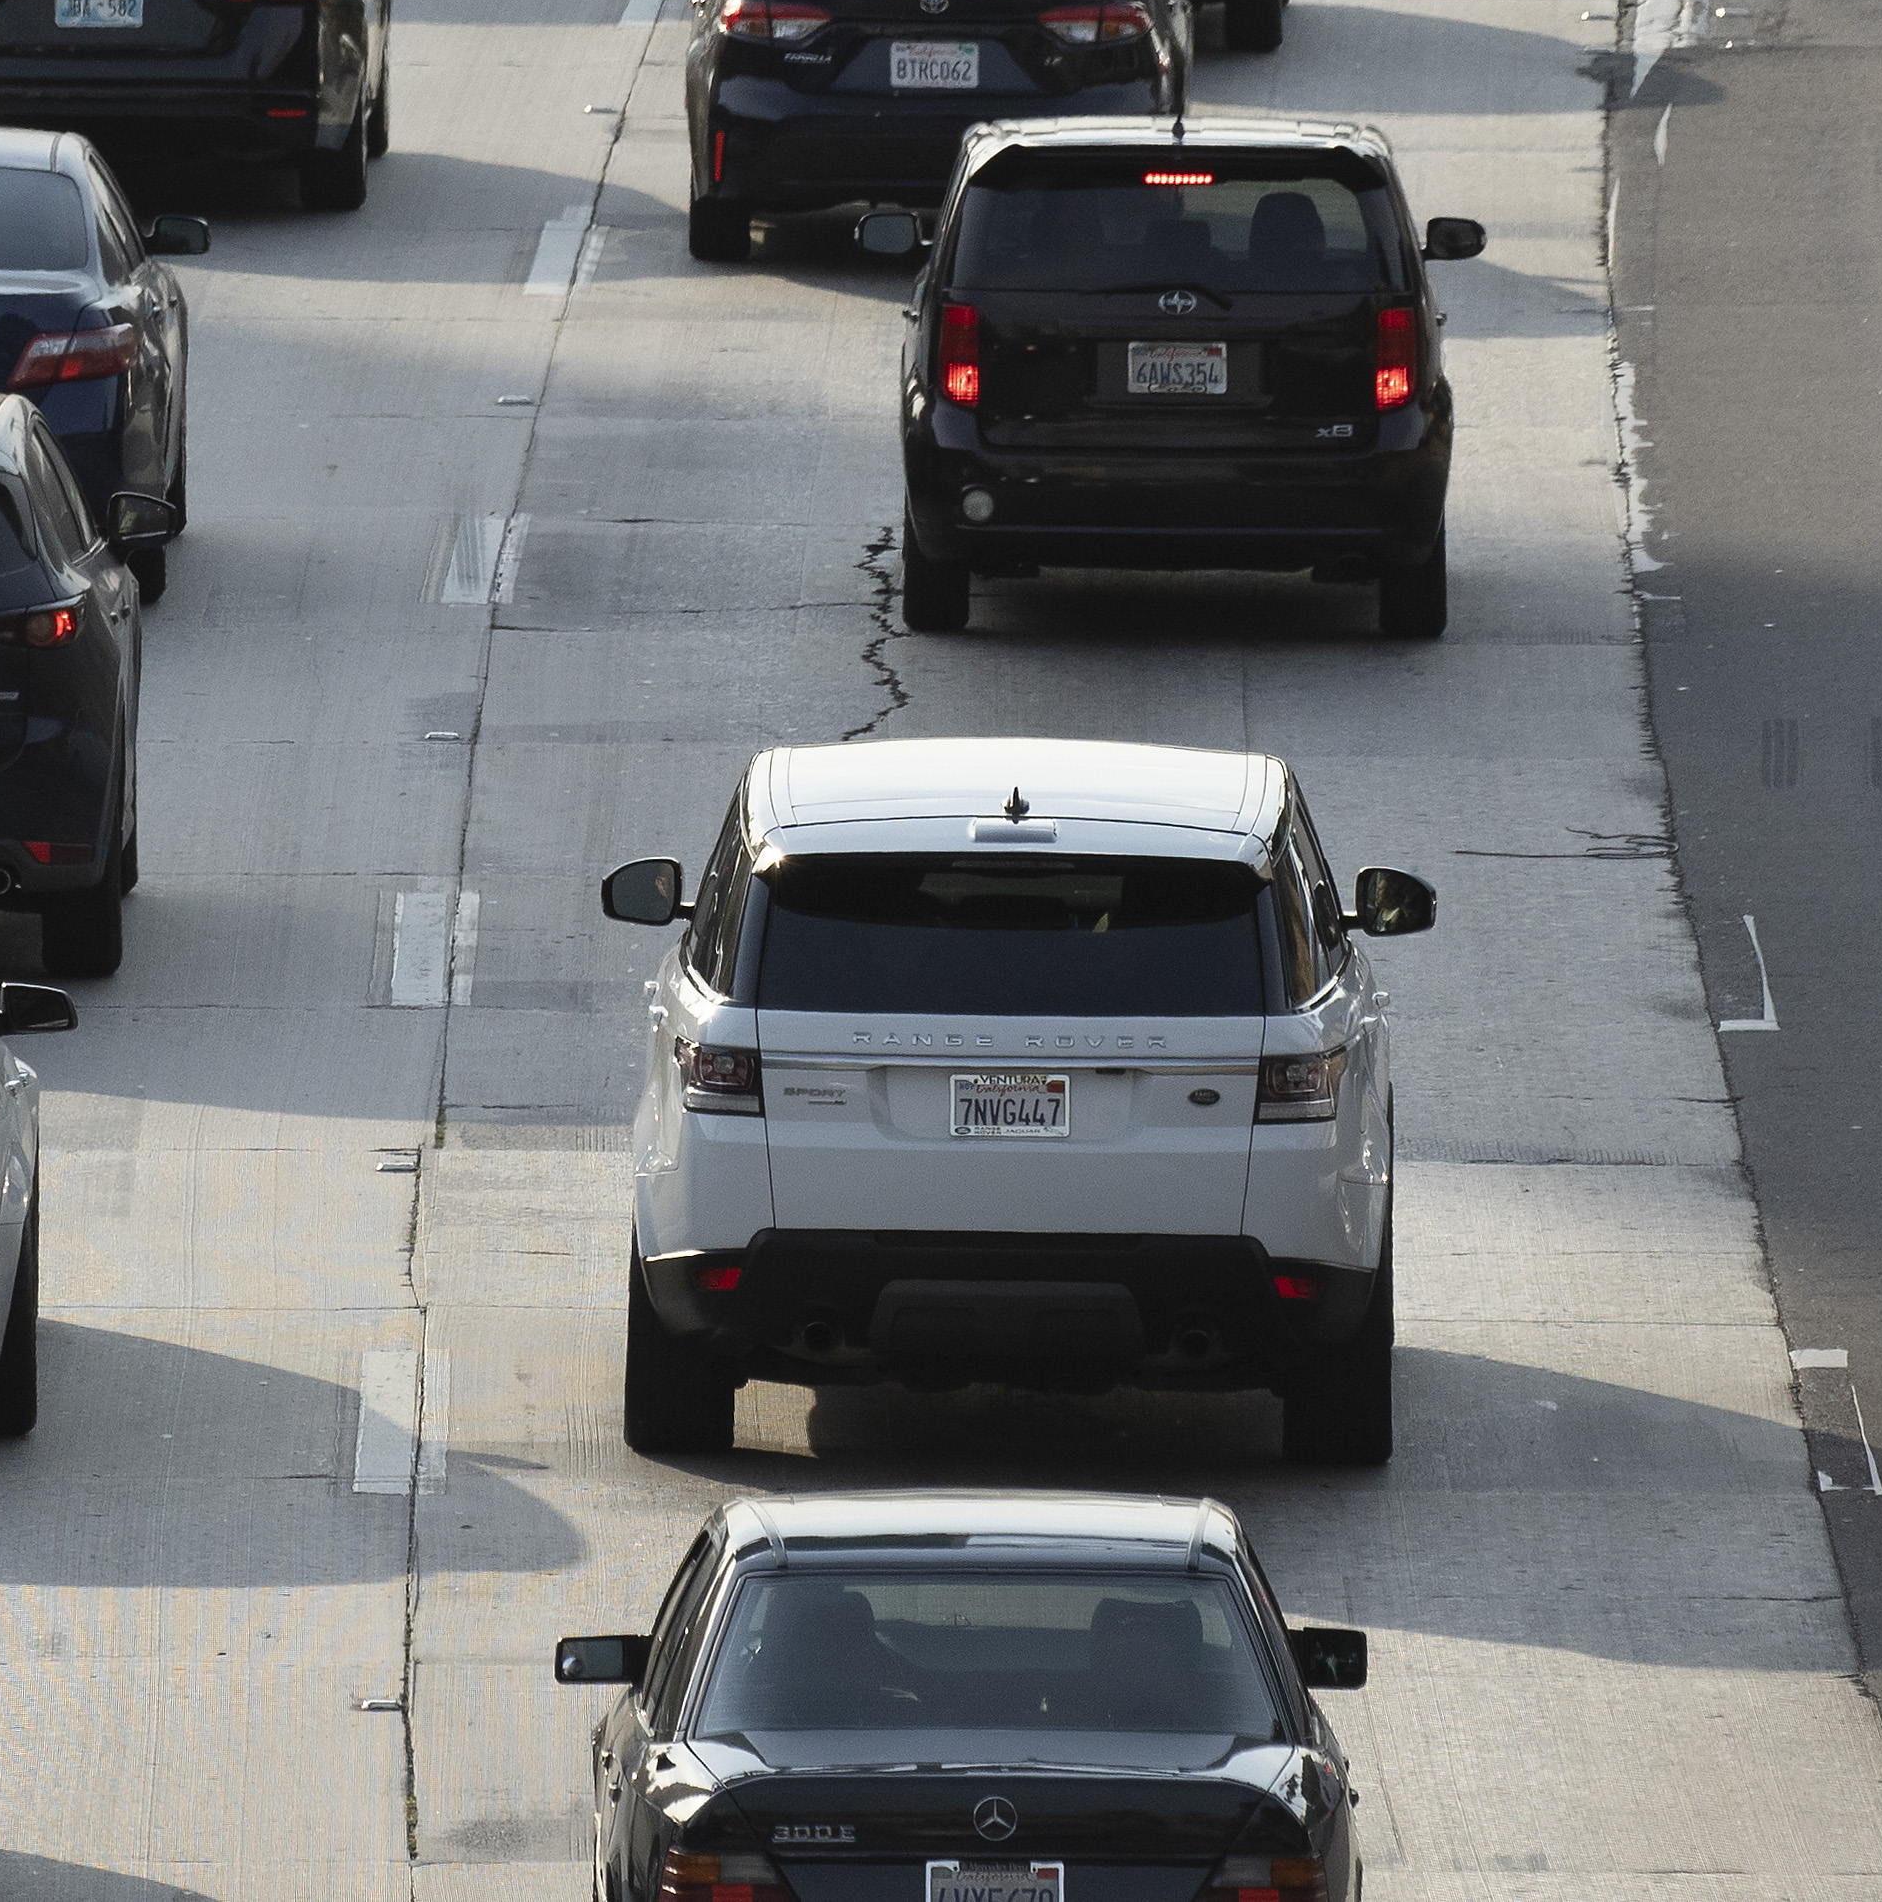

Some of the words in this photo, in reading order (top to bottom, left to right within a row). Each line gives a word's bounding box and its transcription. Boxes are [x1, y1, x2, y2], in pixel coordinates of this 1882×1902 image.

[897, 59, 973, 81] 8TRC062
[1136, 362, 1219, 385] 6AWS354
[852, 1031, 995, 1048] RANGE
[1025, 1035, 1168, 1049] ROVER
[980, 1075, 1041, 1085] VENTURA
[783, 1087, 847, 1097] SPORT
[975, 1084, 1040, 1097] California
[959, 1098, 1061, 1126] 7NVG447
